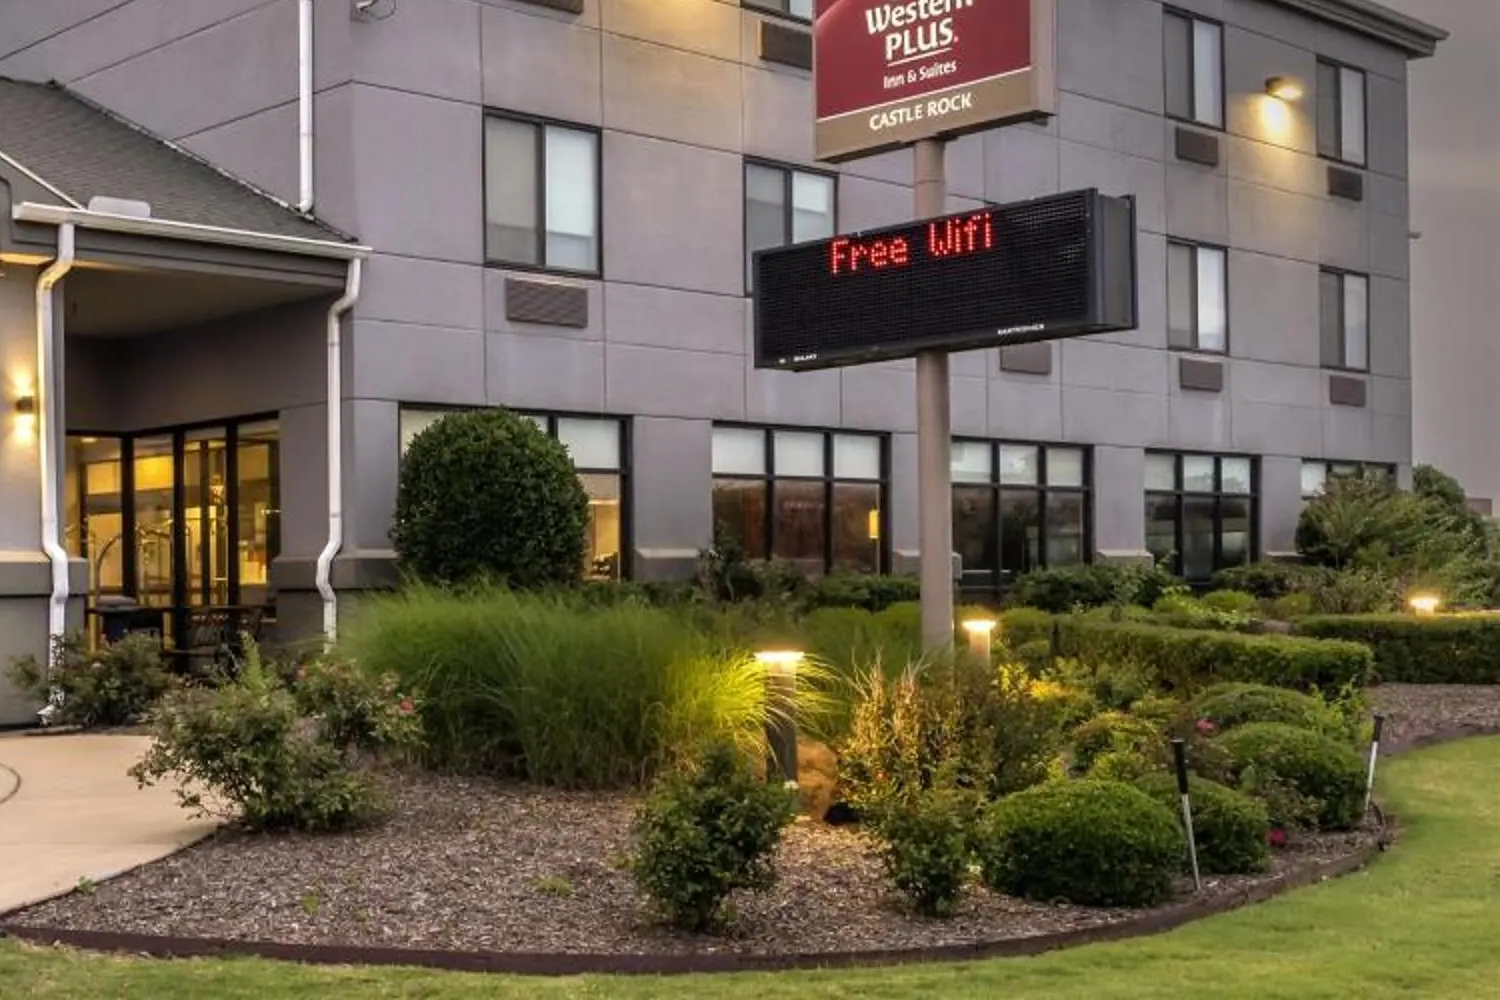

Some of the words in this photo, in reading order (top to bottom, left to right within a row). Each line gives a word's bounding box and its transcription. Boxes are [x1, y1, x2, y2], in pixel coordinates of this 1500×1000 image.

[883, 74, 905, 89] Inn
[907, 69, 917, 83] &
[919, 60, 957, 81] Suites
[869, 104, 923, 131] CASTLE
[927, 92, 972, 117] ROCK
[832, 239, 907, 274] Free
[929, 212, 992, 256] Wifi
